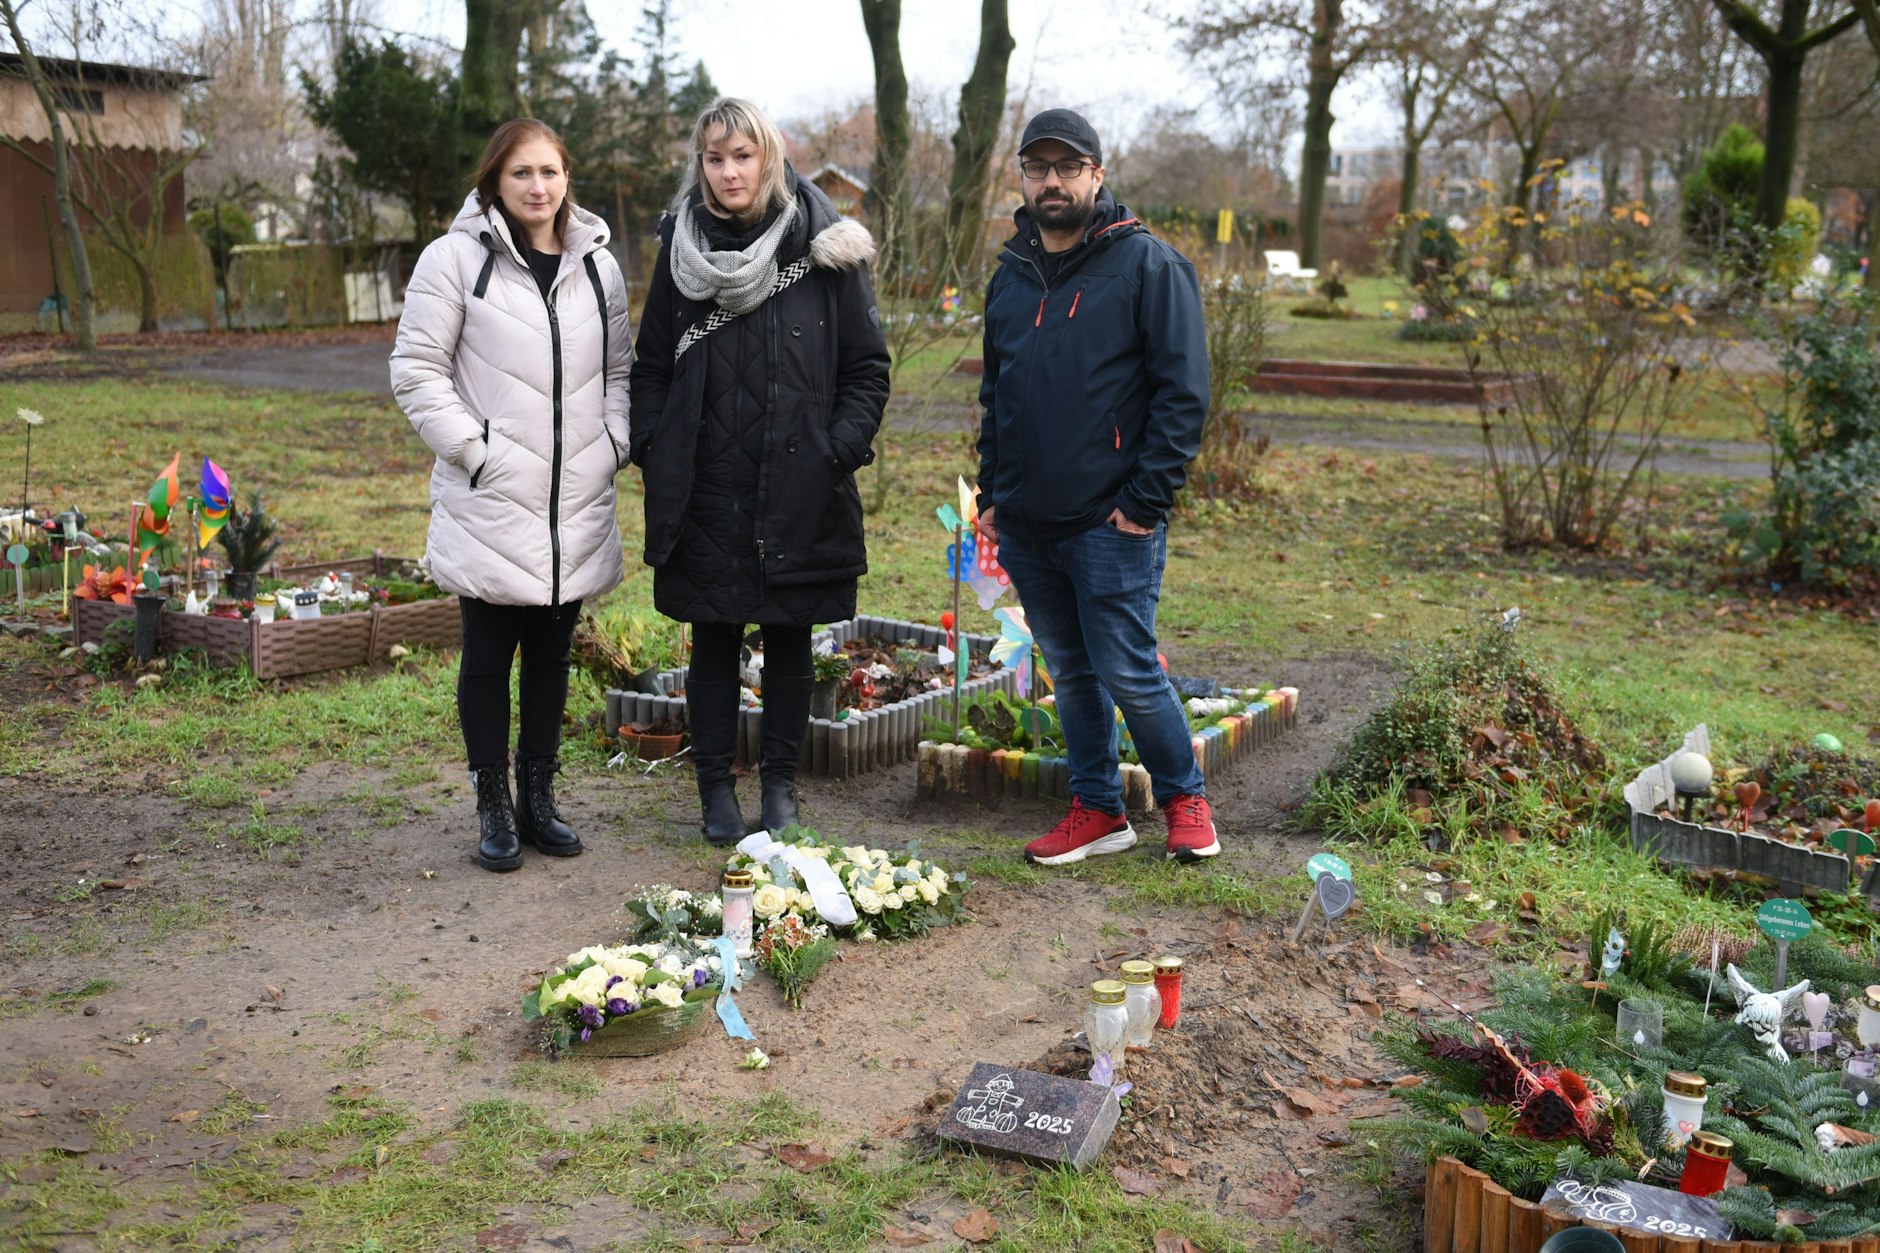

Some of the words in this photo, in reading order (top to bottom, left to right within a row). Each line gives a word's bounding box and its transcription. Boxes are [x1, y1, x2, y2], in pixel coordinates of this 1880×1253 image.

[1758, 913, 1793, 926] Stillgeborenes
[1795, 919, 1810, 929] Leben
[1023, 1111, 1074, 1134] 2025
[1643, 1215, 1707, 1238] 2025
